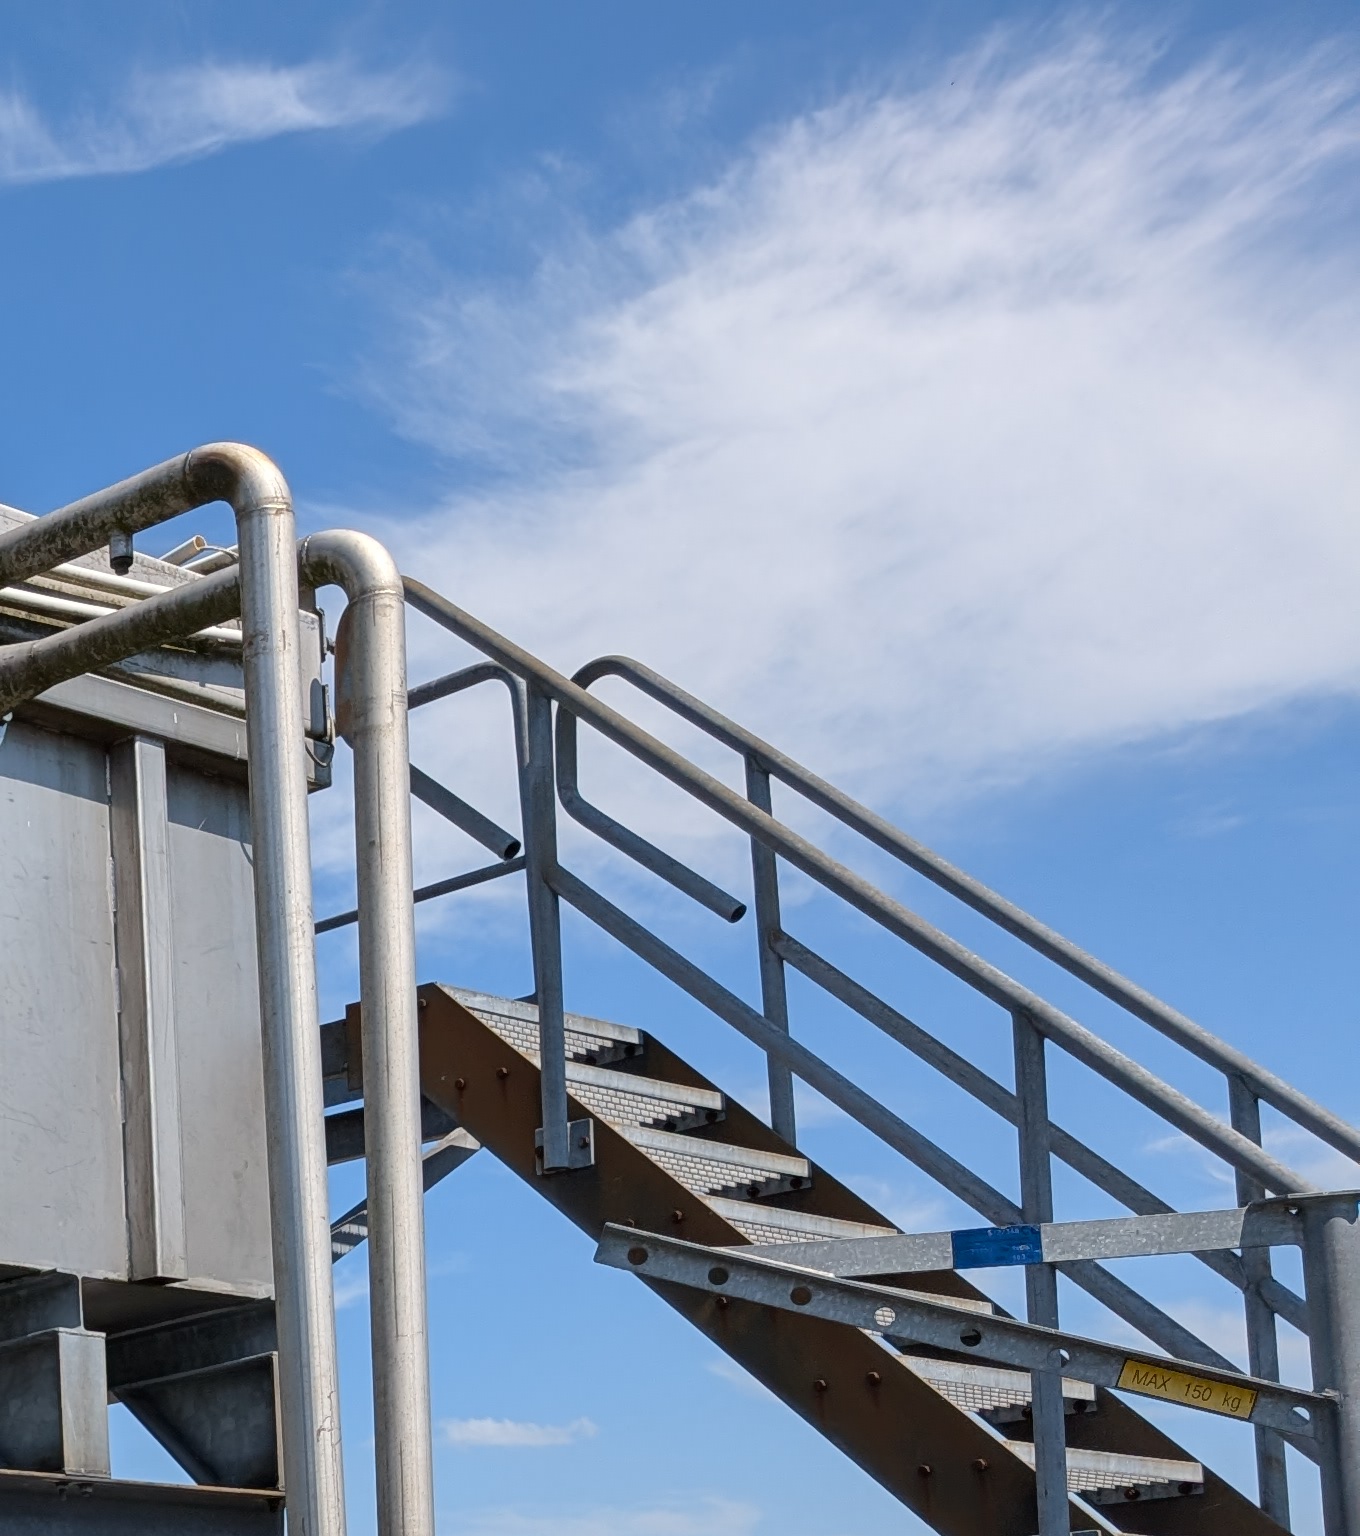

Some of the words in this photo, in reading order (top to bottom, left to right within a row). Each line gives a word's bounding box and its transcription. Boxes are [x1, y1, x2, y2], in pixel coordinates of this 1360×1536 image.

[1132, 1369, 1172, 1392] MAX
[1184, 1383, 1212, 1402] 150
[1221, 1391, 1242, 1412] kg
